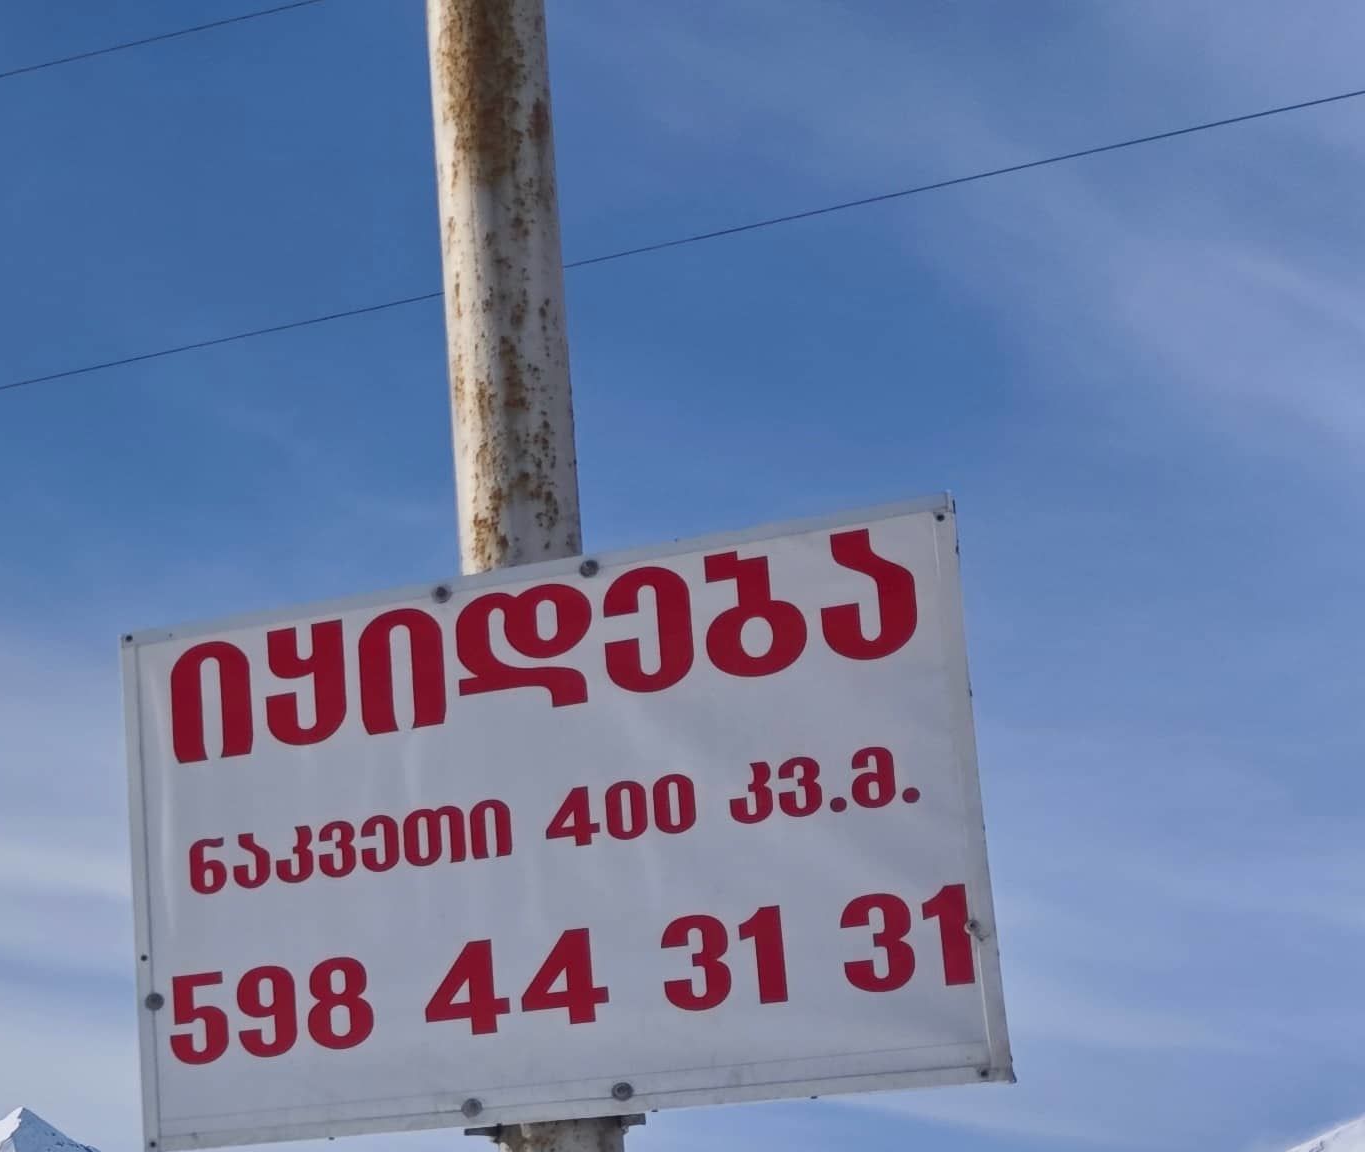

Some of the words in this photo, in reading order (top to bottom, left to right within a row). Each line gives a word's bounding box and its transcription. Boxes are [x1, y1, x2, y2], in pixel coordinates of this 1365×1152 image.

[170, 529, 918, 763] იყიდება
[188, 799, 512, 894] ნაკვეთი
[546, 774, 697, 847] 400
[729, 747, 921, 823] კვ.მ.
[170, 957, 375, 1065] 598
[425, 928, 609, 1036] 44
[661, 905, 788, 1011] 31
[840, 883, 976, 993] 31
